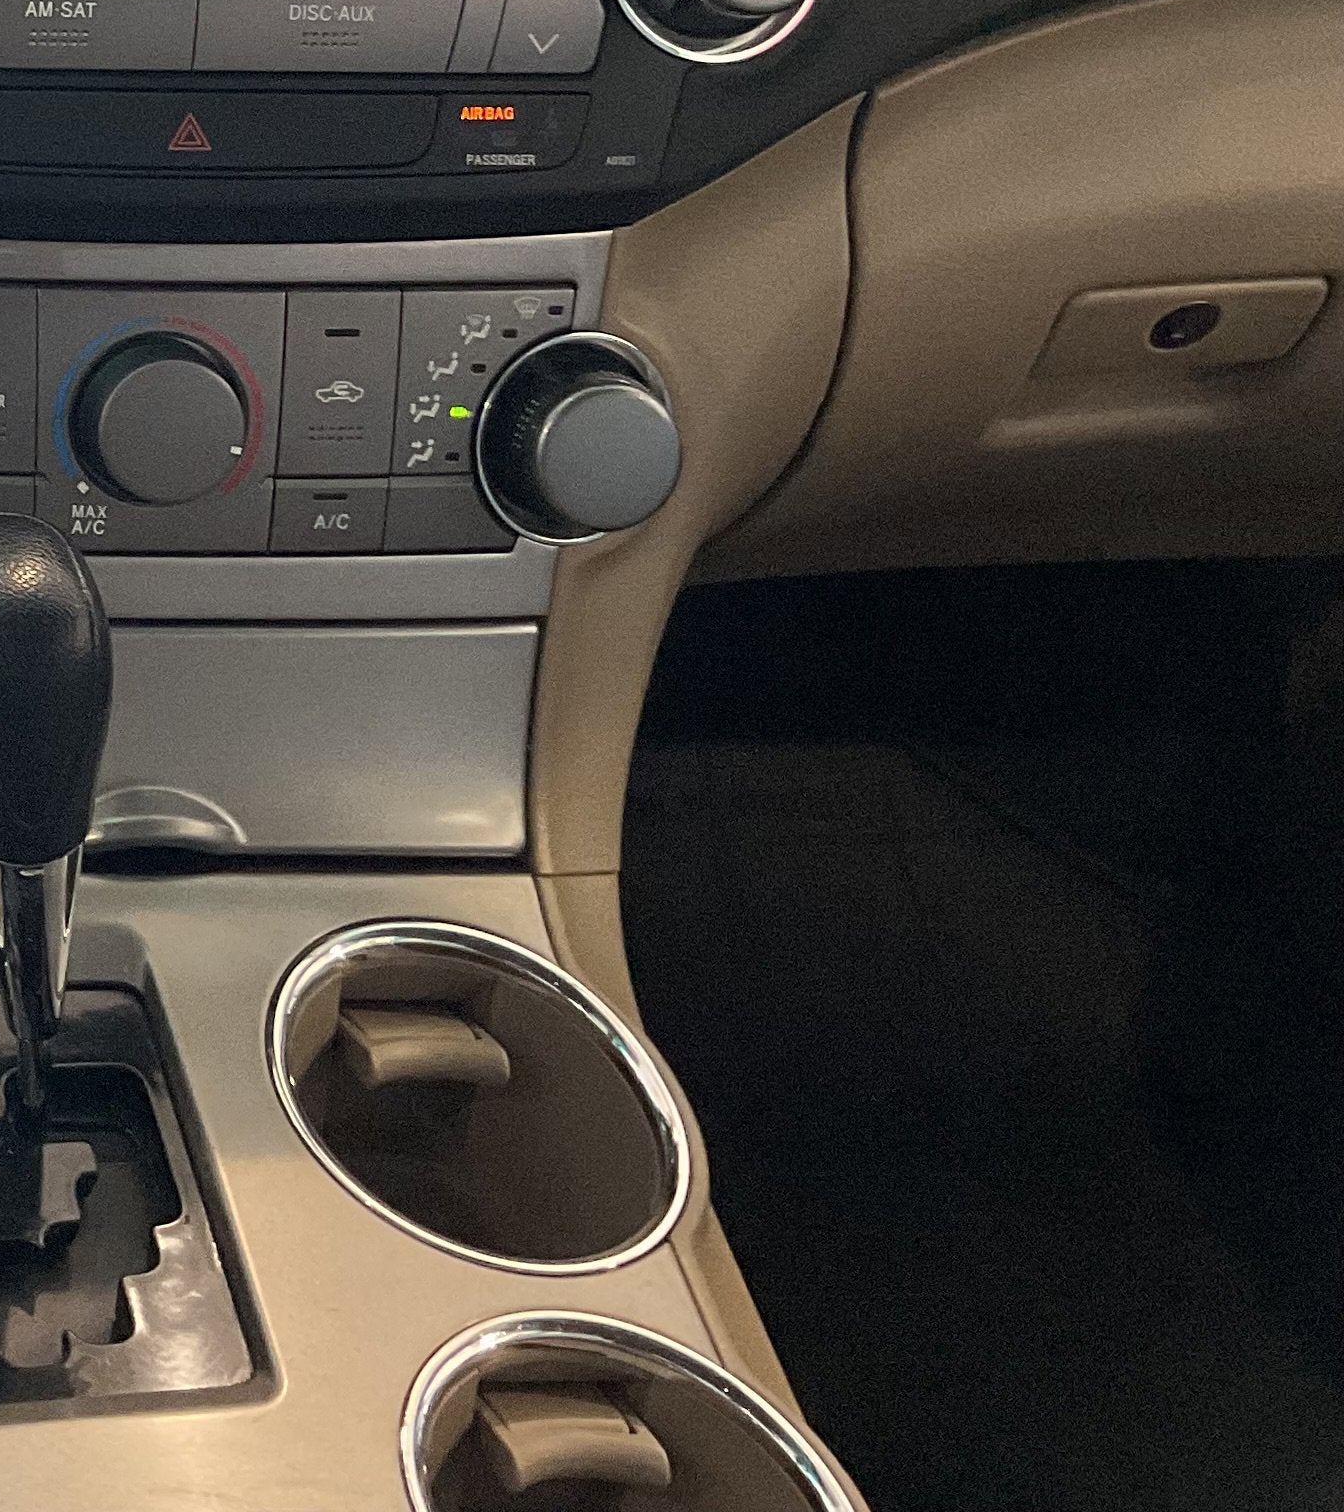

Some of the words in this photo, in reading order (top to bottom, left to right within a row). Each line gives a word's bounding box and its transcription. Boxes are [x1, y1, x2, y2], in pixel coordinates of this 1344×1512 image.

[460, 107, 515, 120] AIRBAG
[466, 154, 536, 166] PASSENGER
[71, 504, 107, 518] MAX
[71, 520, 105, 535] A/C
[313, 514, 350, 529] A/C
